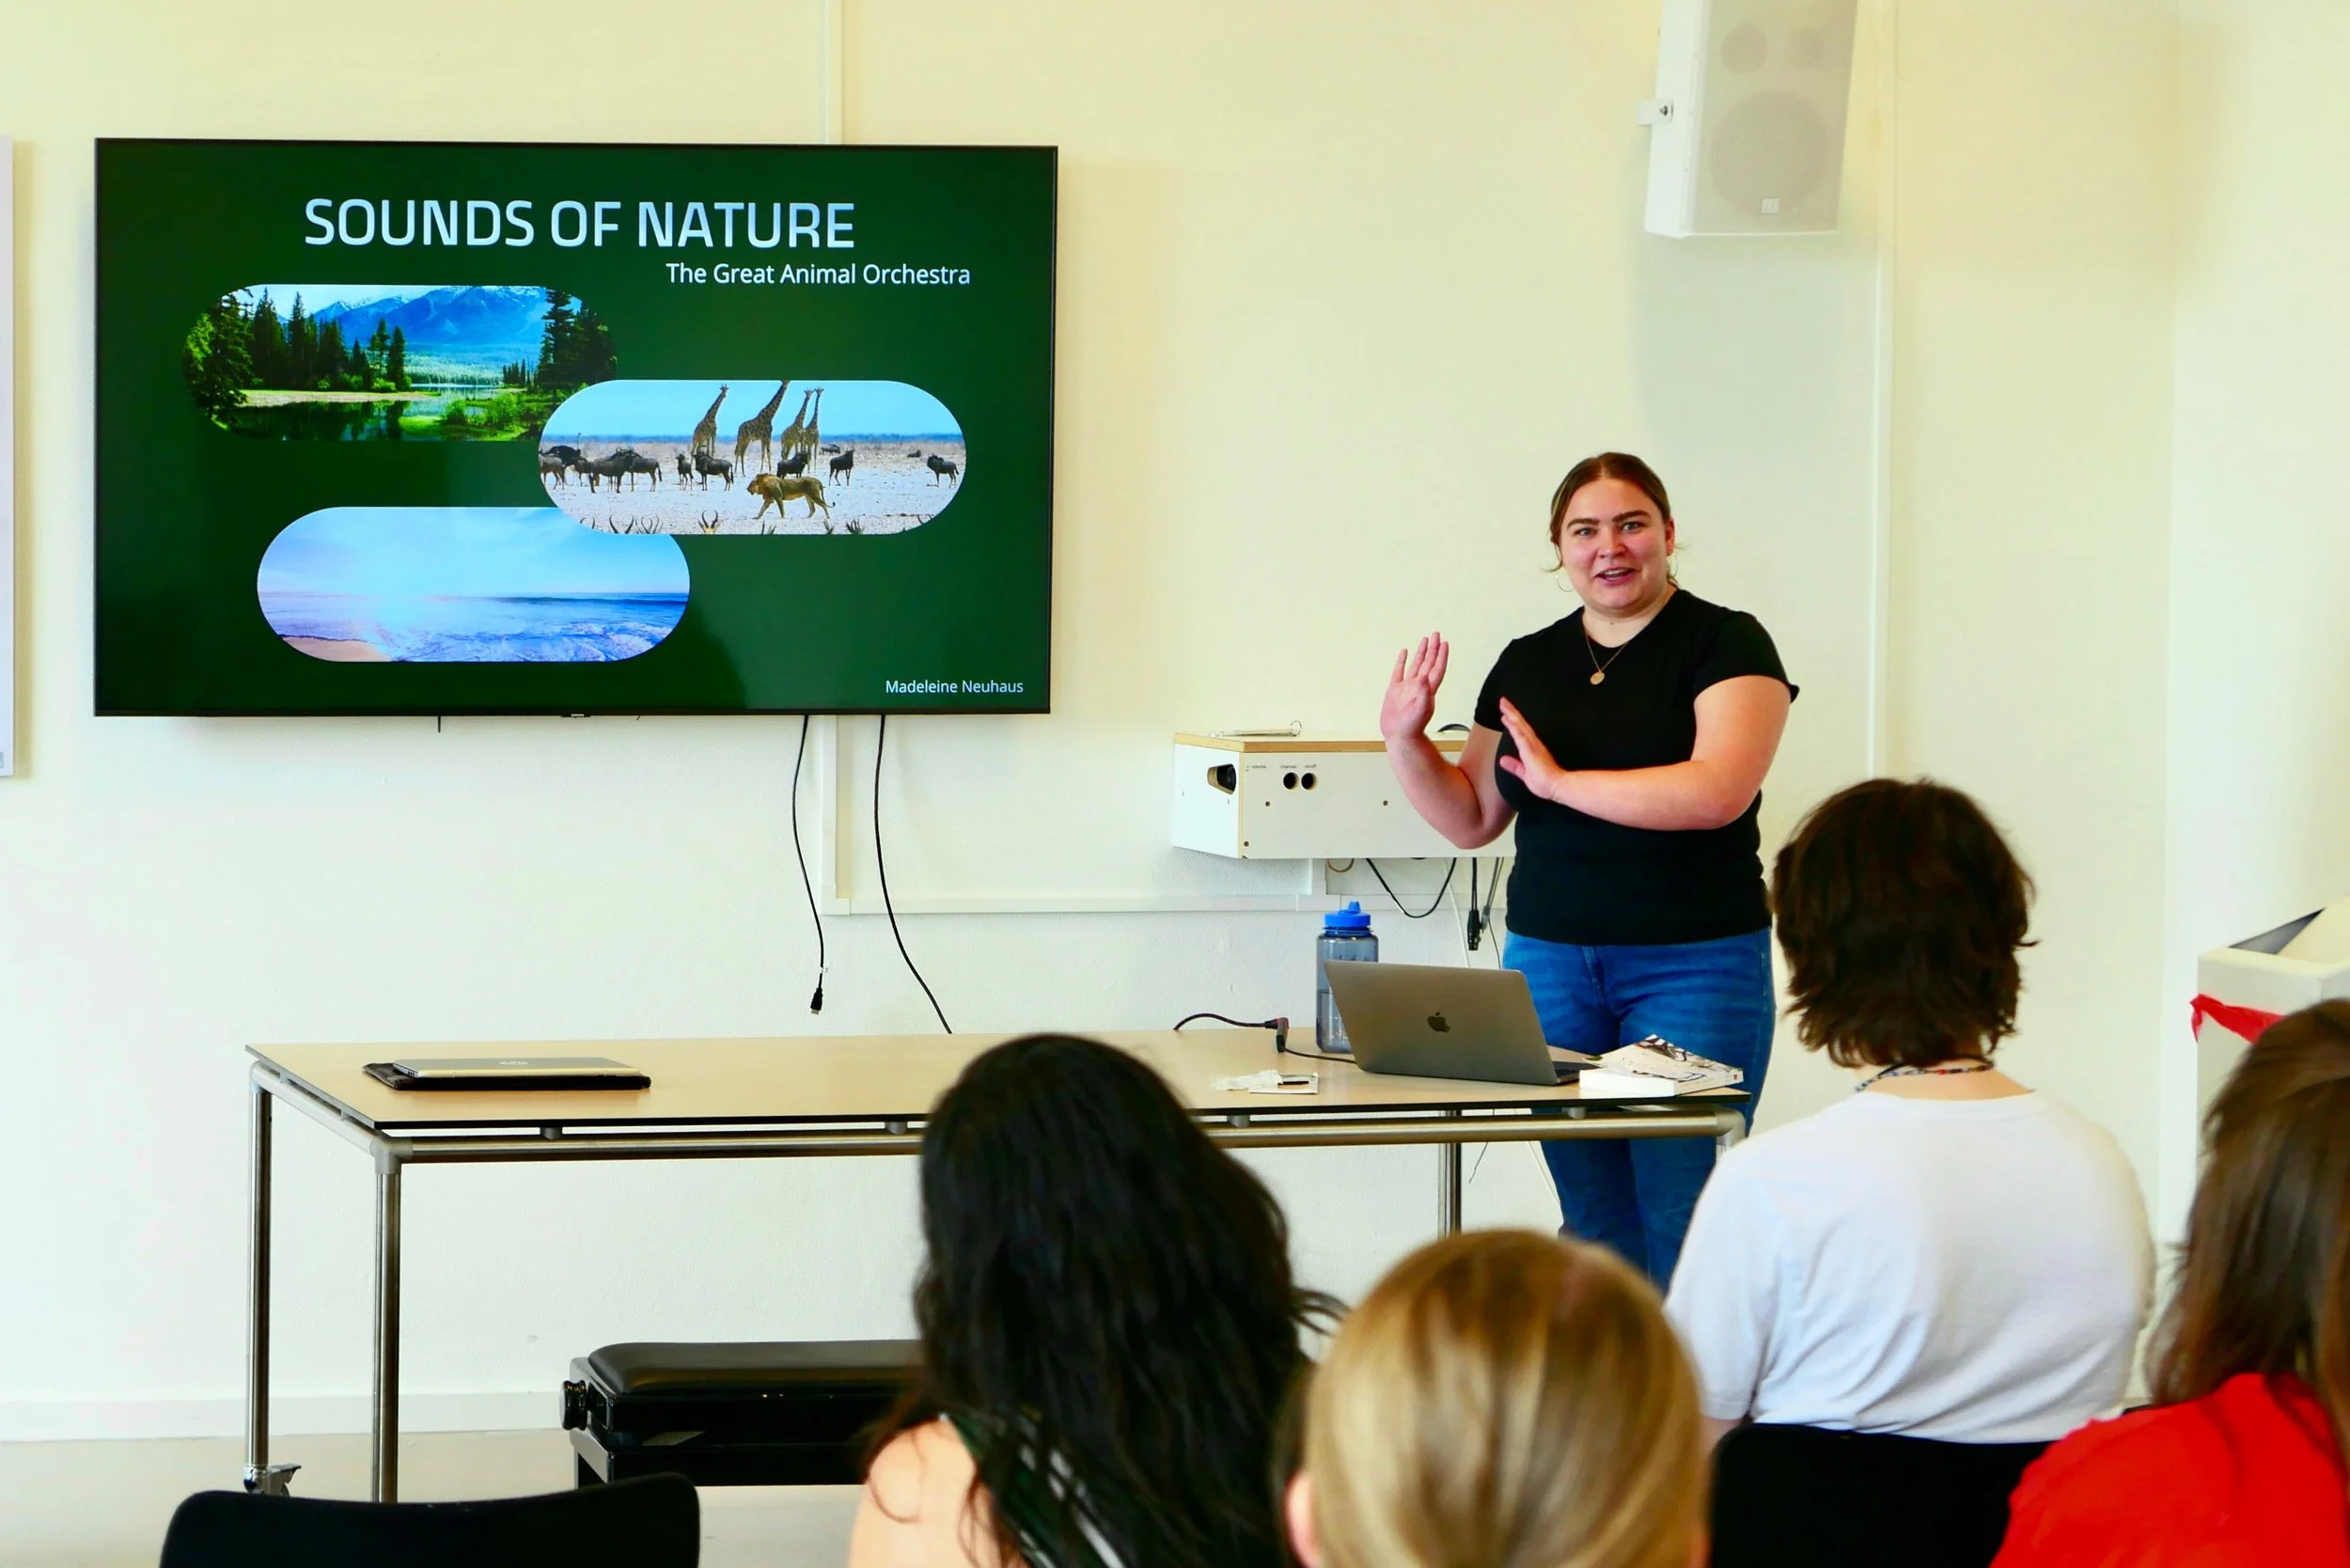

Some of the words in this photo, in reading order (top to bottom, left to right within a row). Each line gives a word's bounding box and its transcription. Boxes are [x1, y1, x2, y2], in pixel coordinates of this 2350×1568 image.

[304, 197, 534, 247] SOUNDS
[550, 199, 621, 248] OF
[638, 200, 854, 249] NATURE
[666, 261, 707, 284] The
[713, 262, 775, 285] Great
[779, 262, 855, 285] Animal
[863, 262, 970, 286] Orchestra
[885, 679, 958, 694] Madeleine
[962, 679, 1025, 694] Neuhaus
